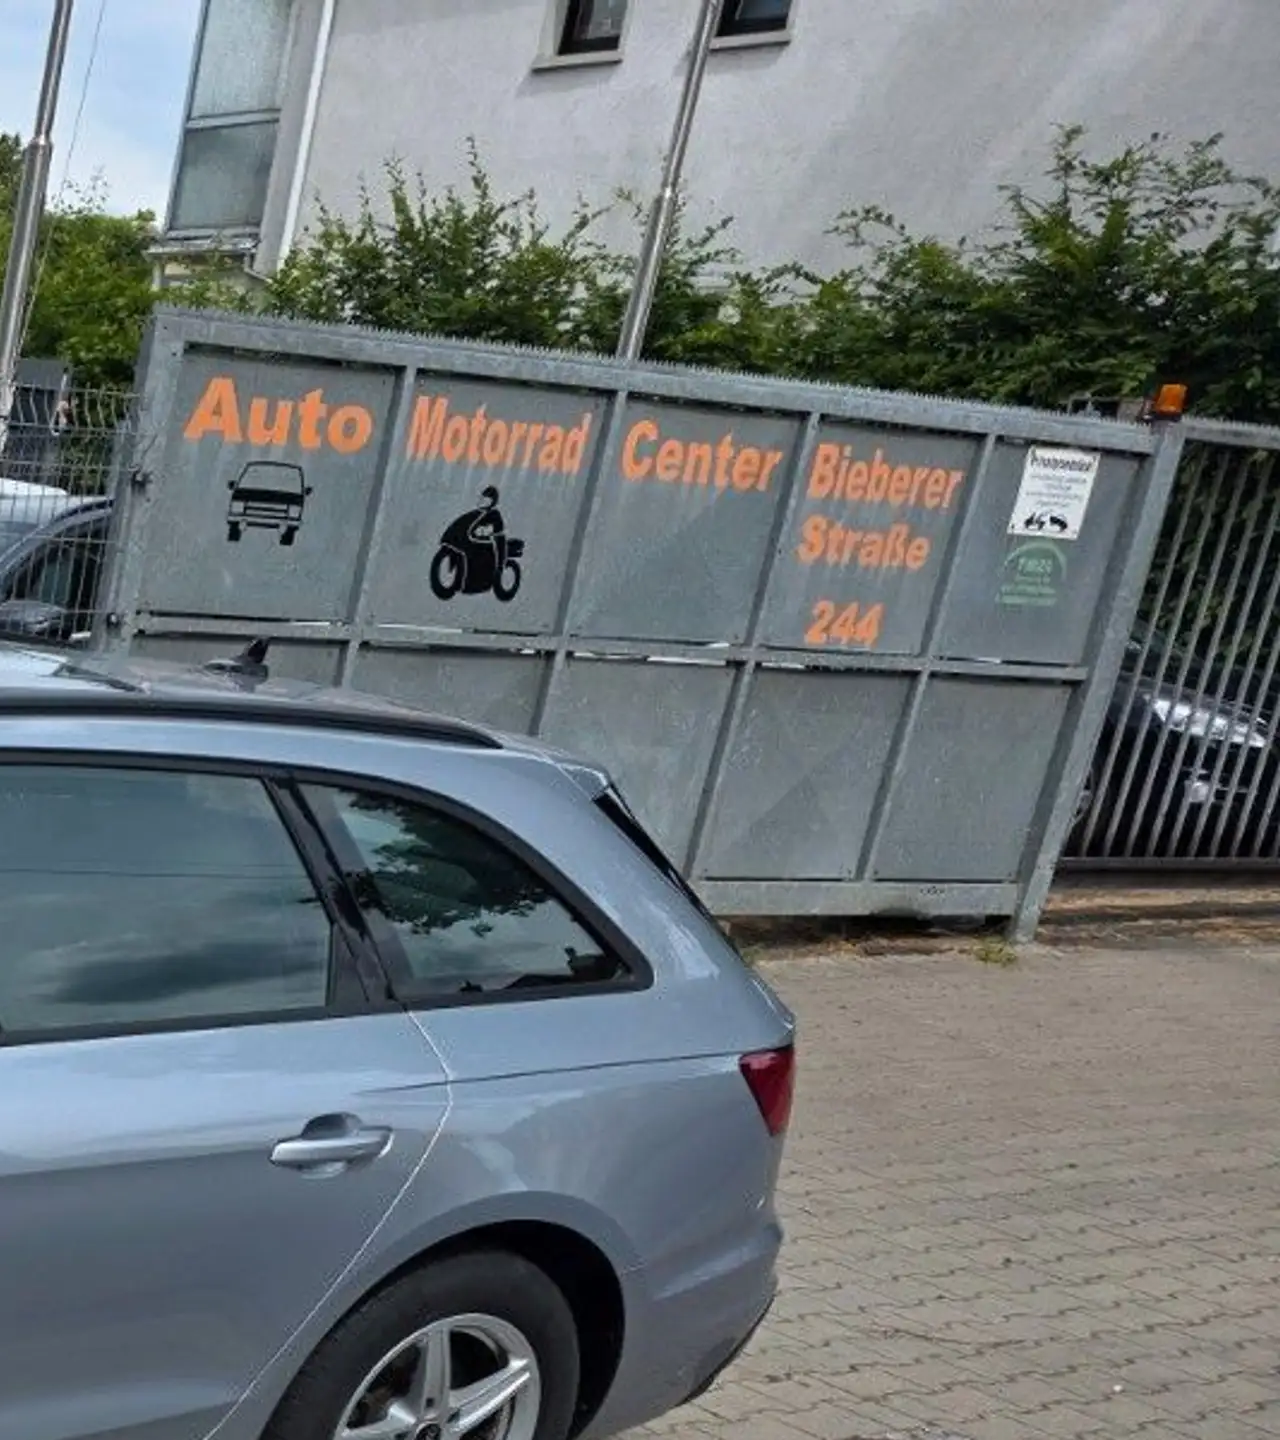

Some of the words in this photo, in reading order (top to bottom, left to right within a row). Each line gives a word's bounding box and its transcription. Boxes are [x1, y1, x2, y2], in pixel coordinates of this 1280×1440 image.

[183, 376, 372, 453] Auto
[406, 395, 591, 475] Motorrad
[621, 420, 783, 491] Center
[807, 443, 964, 508] Bieberer
[798, 514, 930, 569] Straße
[805, 601, 883, 647] 244
